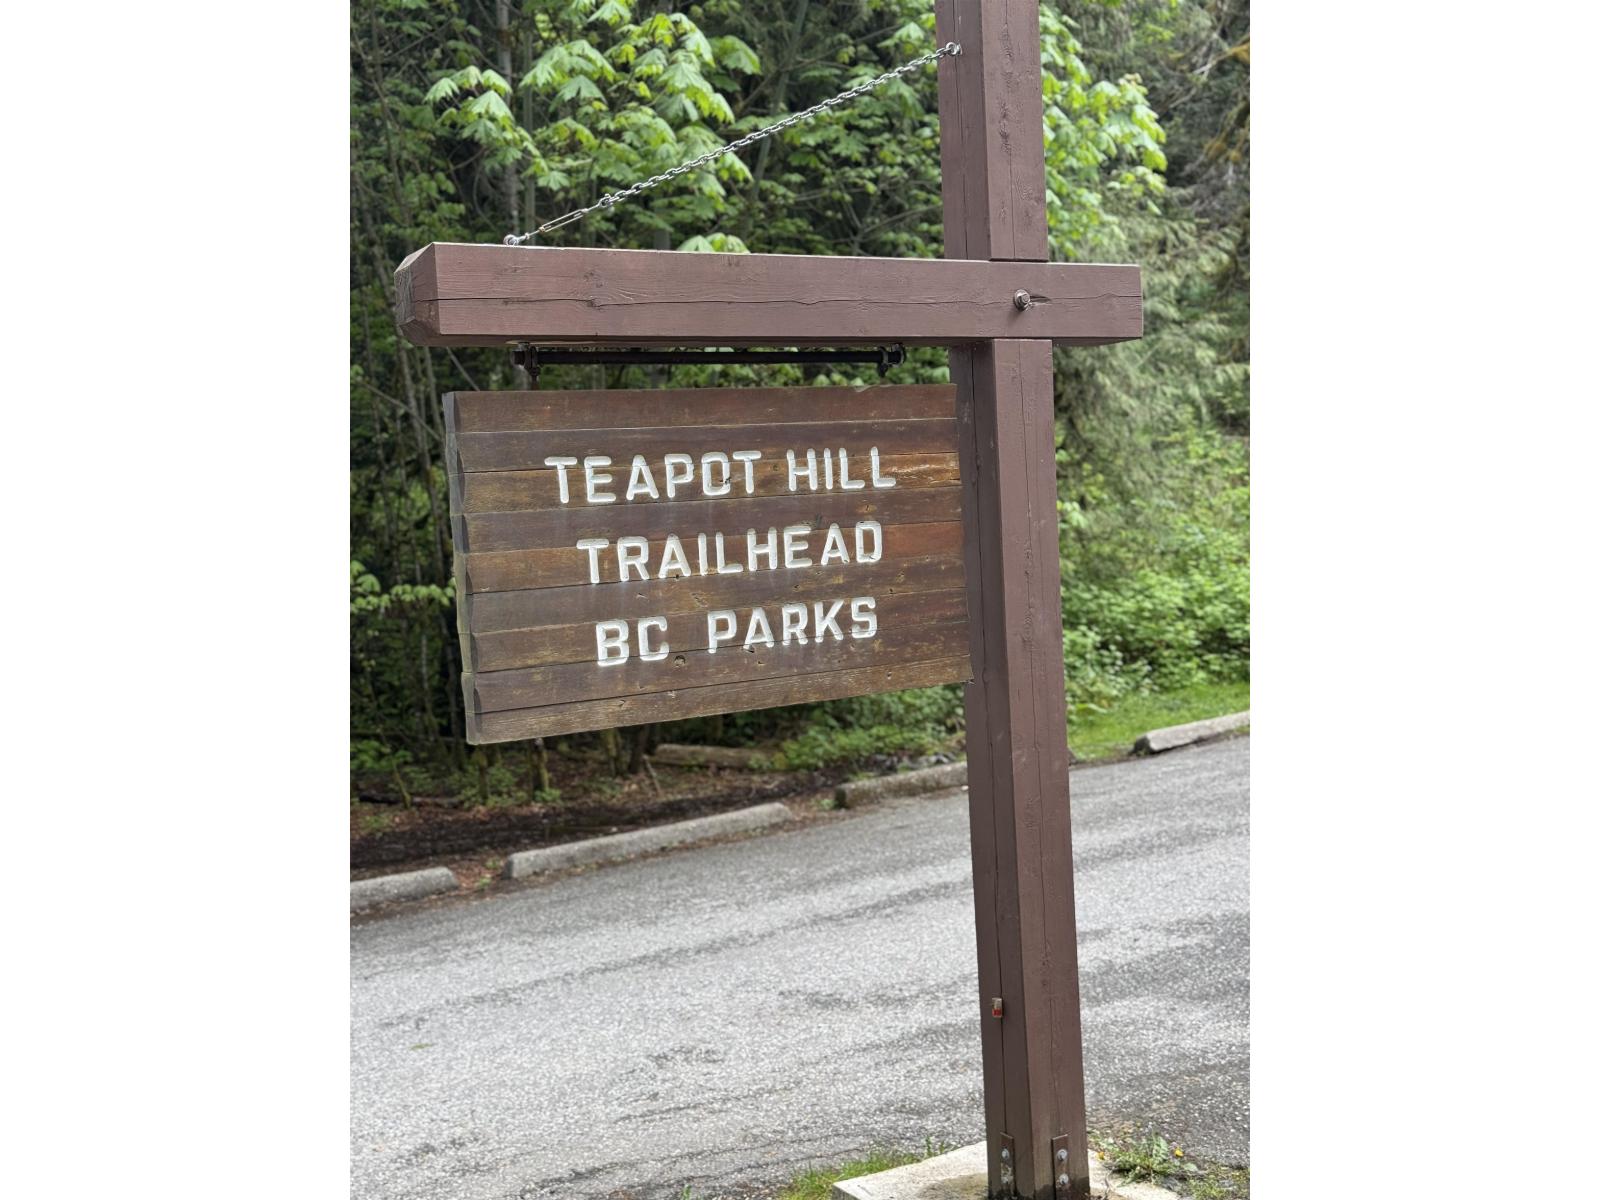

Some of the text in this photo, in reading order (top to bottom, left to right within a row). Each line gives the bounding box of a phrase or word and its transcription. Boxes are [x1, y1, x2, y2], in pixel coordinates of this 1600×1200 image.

[543, 446, 898, 505] TEAPOT HILL
[575, 519, 884, 586] TRAILHEAD
[594, 596, 879, 668] BC PARKS
